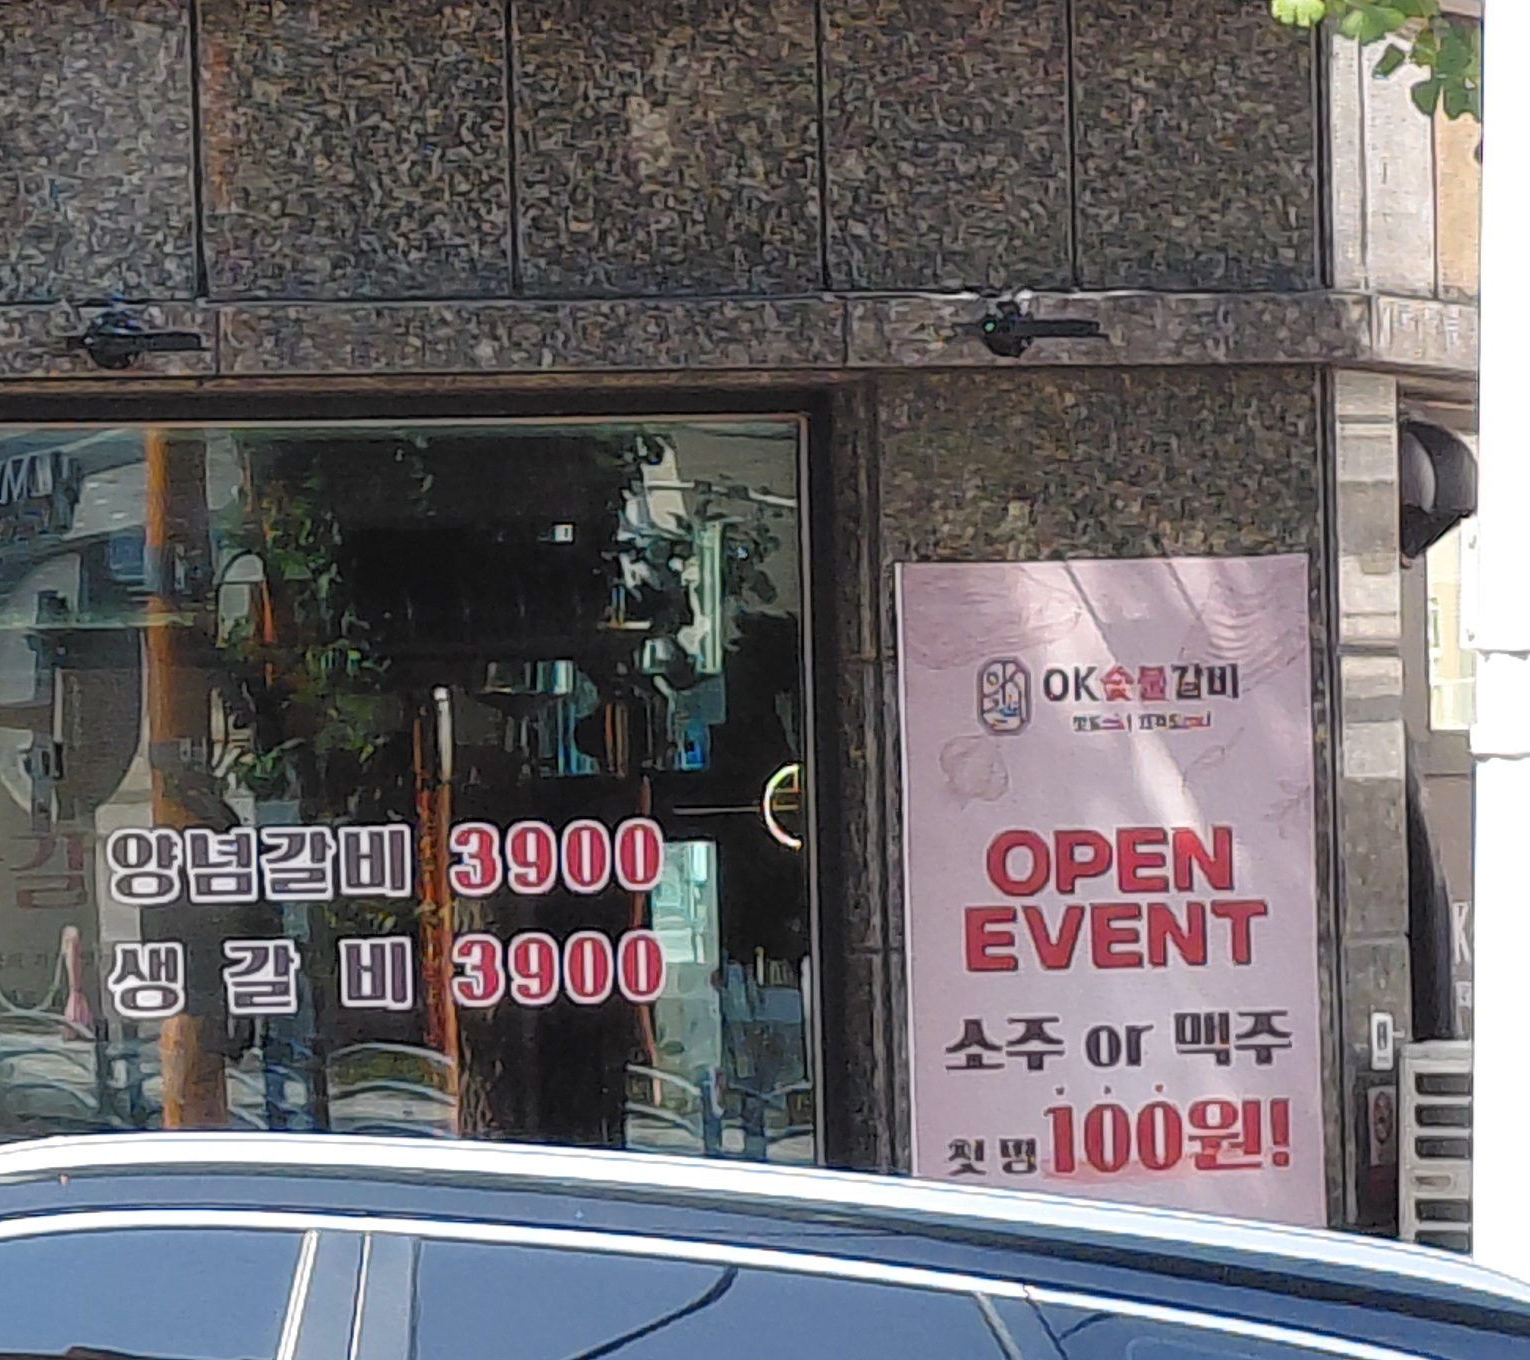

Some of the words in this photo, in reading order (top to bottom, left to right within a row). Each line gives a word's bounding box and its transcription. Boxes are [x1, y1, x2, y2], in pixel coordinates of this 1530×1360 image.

[107, 824, 415, 904] 양념갈비
[450, 817, 666, 896] 3900
[986, 826, 1235, 897] OPEN
[450, 931, 667, 1009] 3900
[963, 900, 1268, 972] EVENT
[945, 1017, 1066, 1071] 소주
[1174, 1010, 1293, 1066] 맥주
[1043, 1097, 1290, 1173] 100원!
